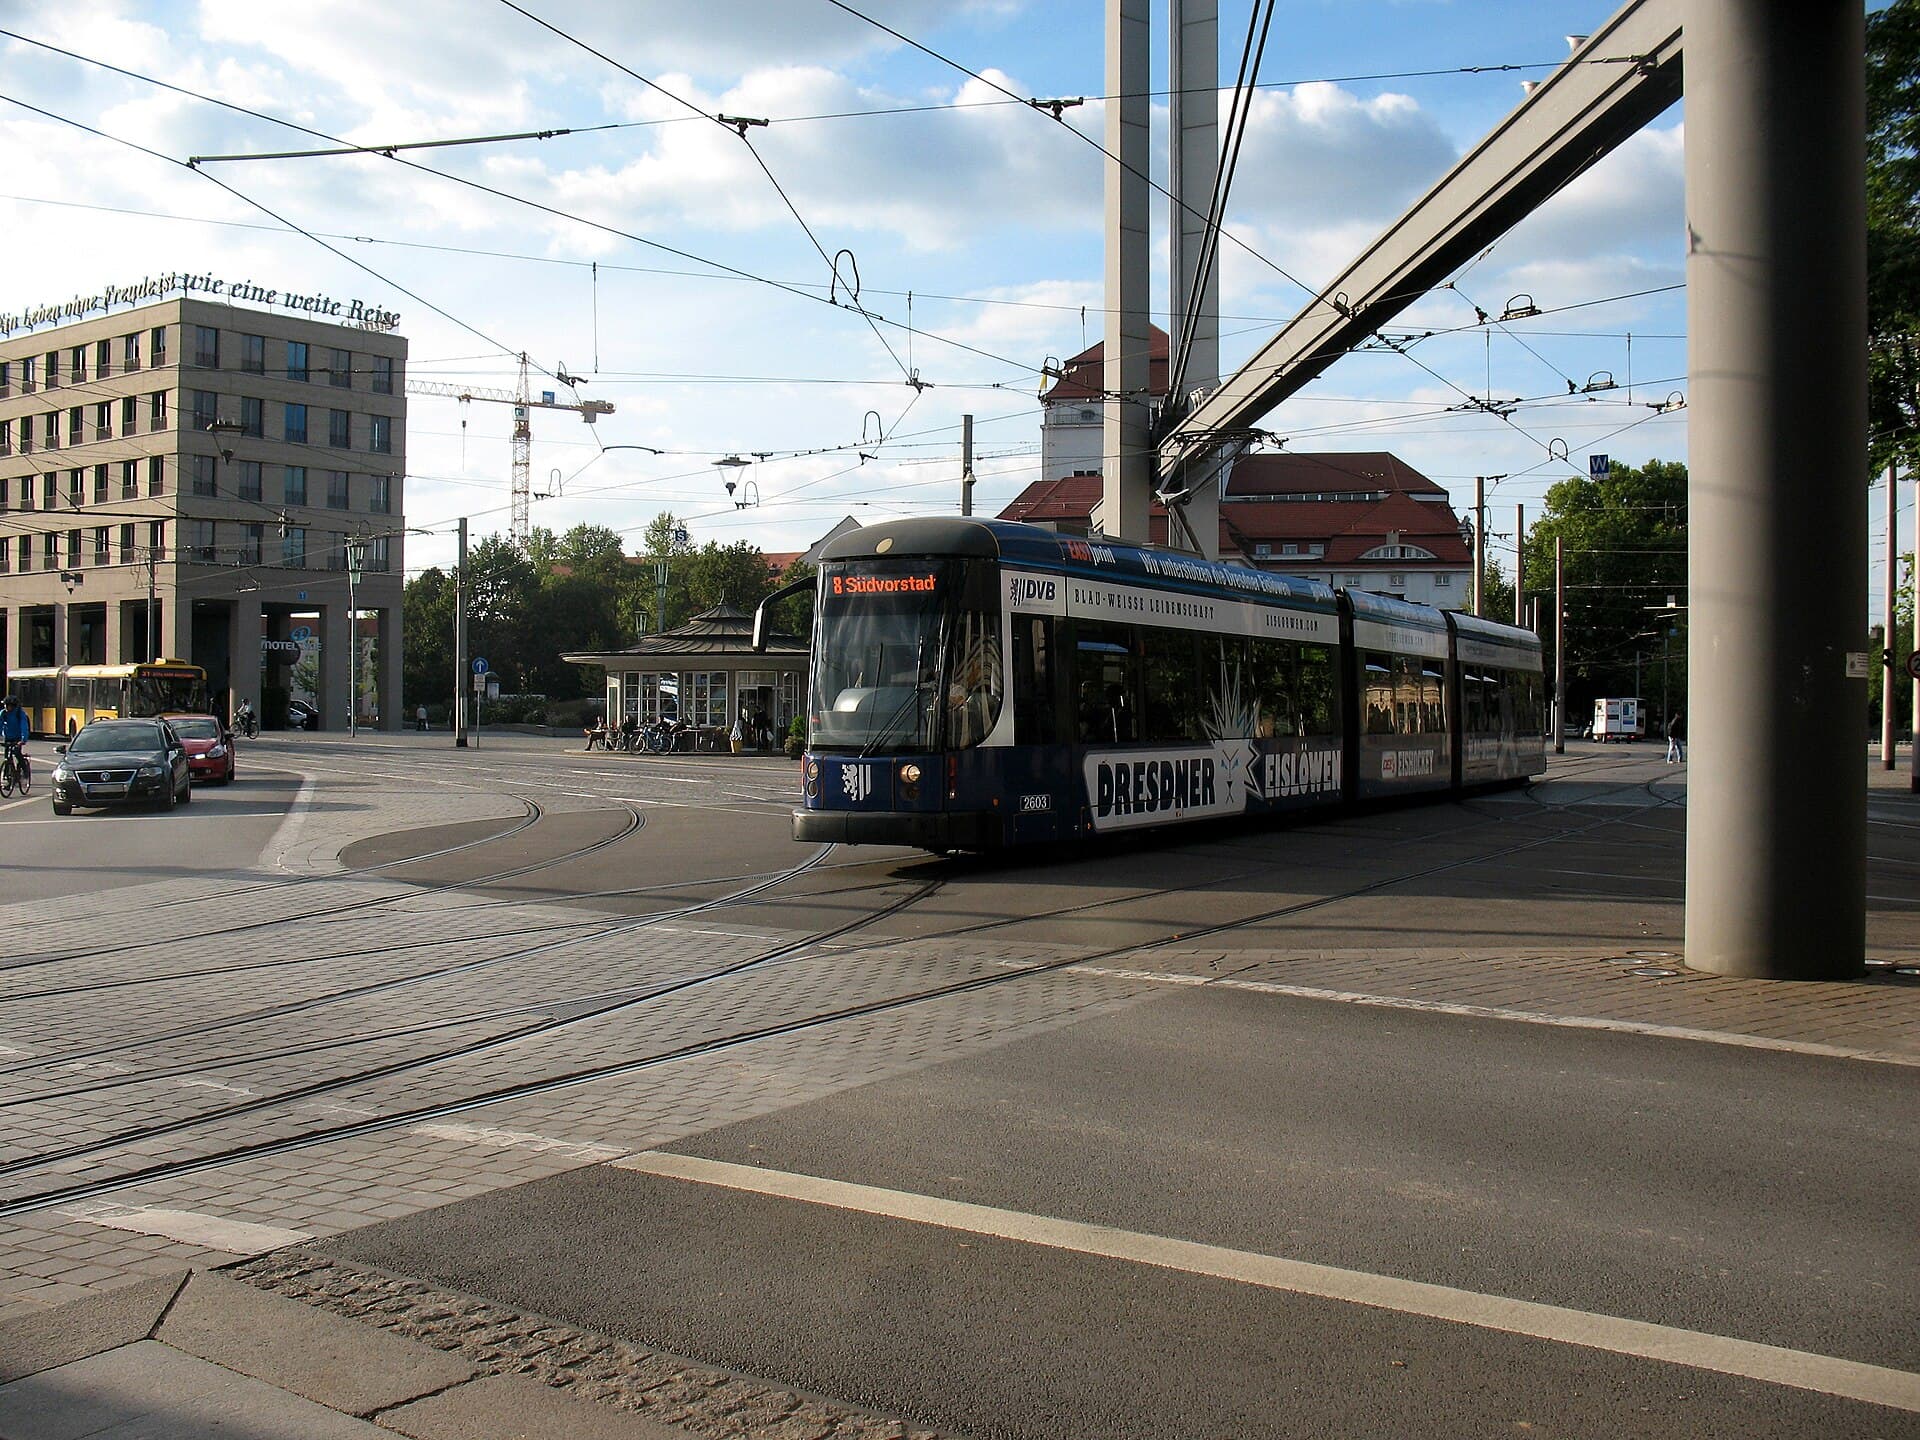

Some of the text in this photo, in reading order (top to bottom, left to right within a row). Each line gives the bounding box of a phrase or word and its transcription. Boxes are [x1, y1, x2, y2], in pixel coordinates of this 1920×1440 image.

[106, 276, 157, 304] Freude
[159, 272, 176, 294] ist
[184, 271, 224, 294] wie
[231, 279, 277, 304] eine
[285, 292, 340, 316] weite
[350, 298, 401, 330] Reise
[1591, 456, 1607, 471] W
[1138, 551, 1160, 575] Wir
[833, 574, 936, 594] 8 Südvorstad
[1026, 579, 1056, 601] DVB
[1074, 588, 1214, 620] BLAU-WEISSE LEIDENSCHAFT
[1098, 744, 1341, 817] DRESDNER EISLÖWEN
[1024, 796, 1047, 810] 2603
